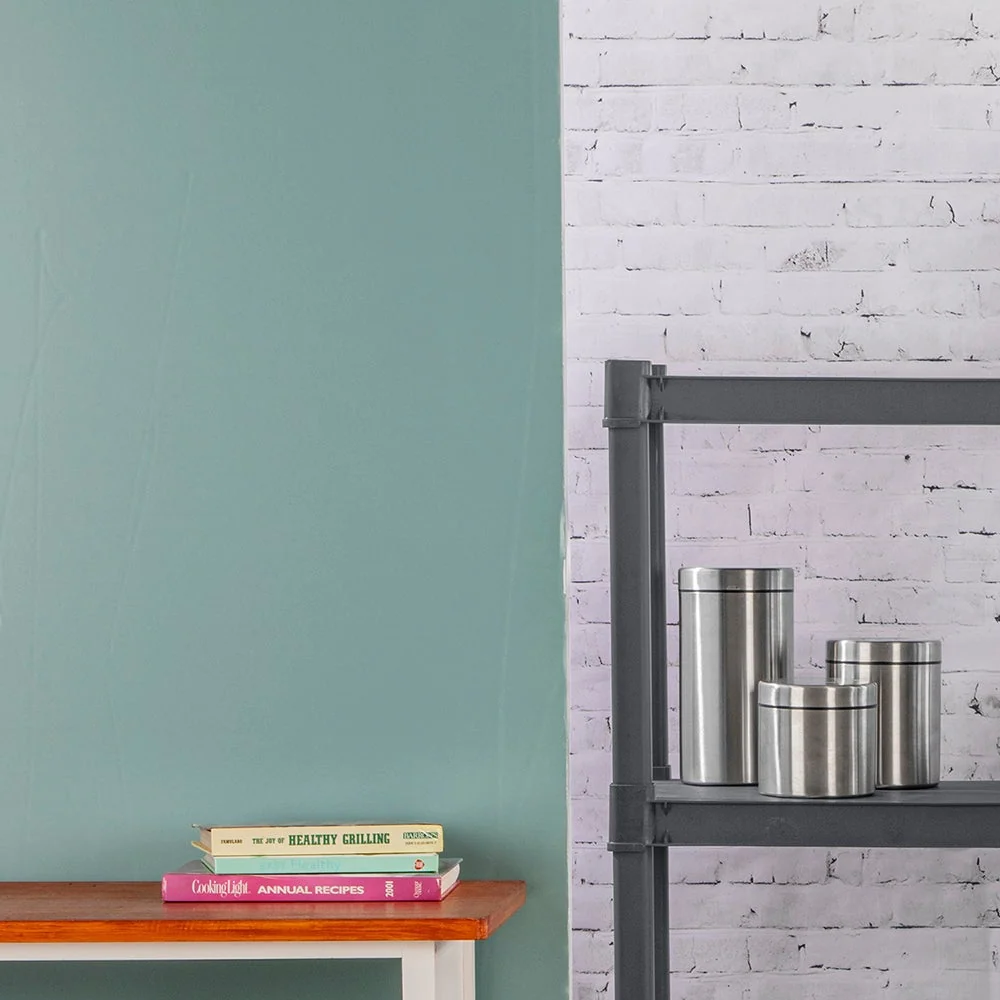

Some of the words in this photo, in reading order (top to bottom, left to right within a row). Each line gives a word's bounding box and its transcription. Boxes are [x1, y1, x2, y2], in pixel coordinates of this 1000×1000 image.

[288, 834, 338, 846] HEALTHY
[342, 833, 390, 845] GRILLING
[257, 885, 312, 895] ANNUAL
[314, 885, 365, 895] RECIPES
